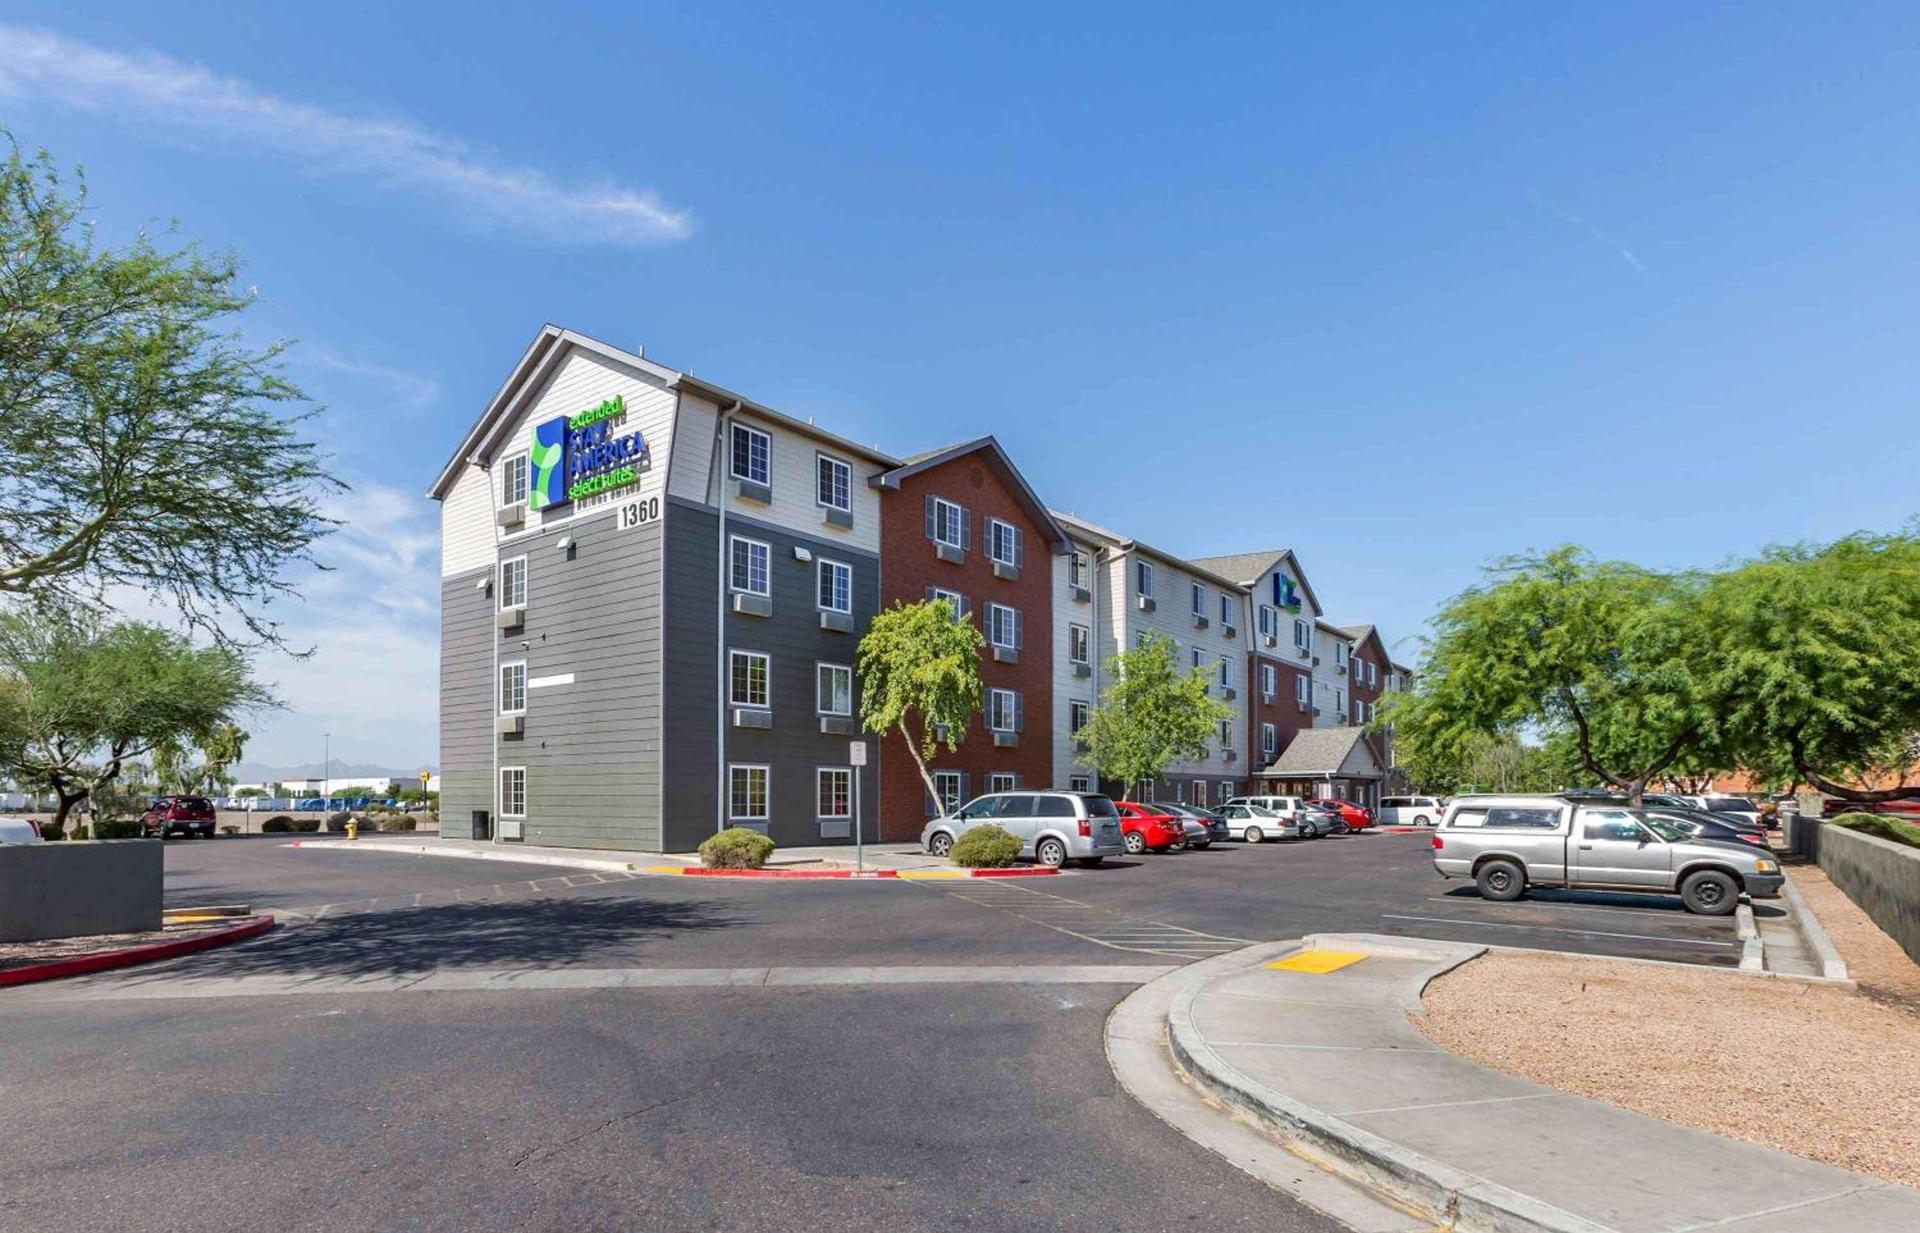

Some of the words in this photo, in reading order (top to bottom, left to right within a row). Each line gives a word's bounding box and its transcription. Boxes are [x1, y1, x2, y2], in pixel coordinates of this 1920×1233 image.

[569, 394, 623, 430] extended
[570, 431, 644, 474] AMERICA
[568, 474, 603, 500] select
[622, 497, 658, 527] 1360
